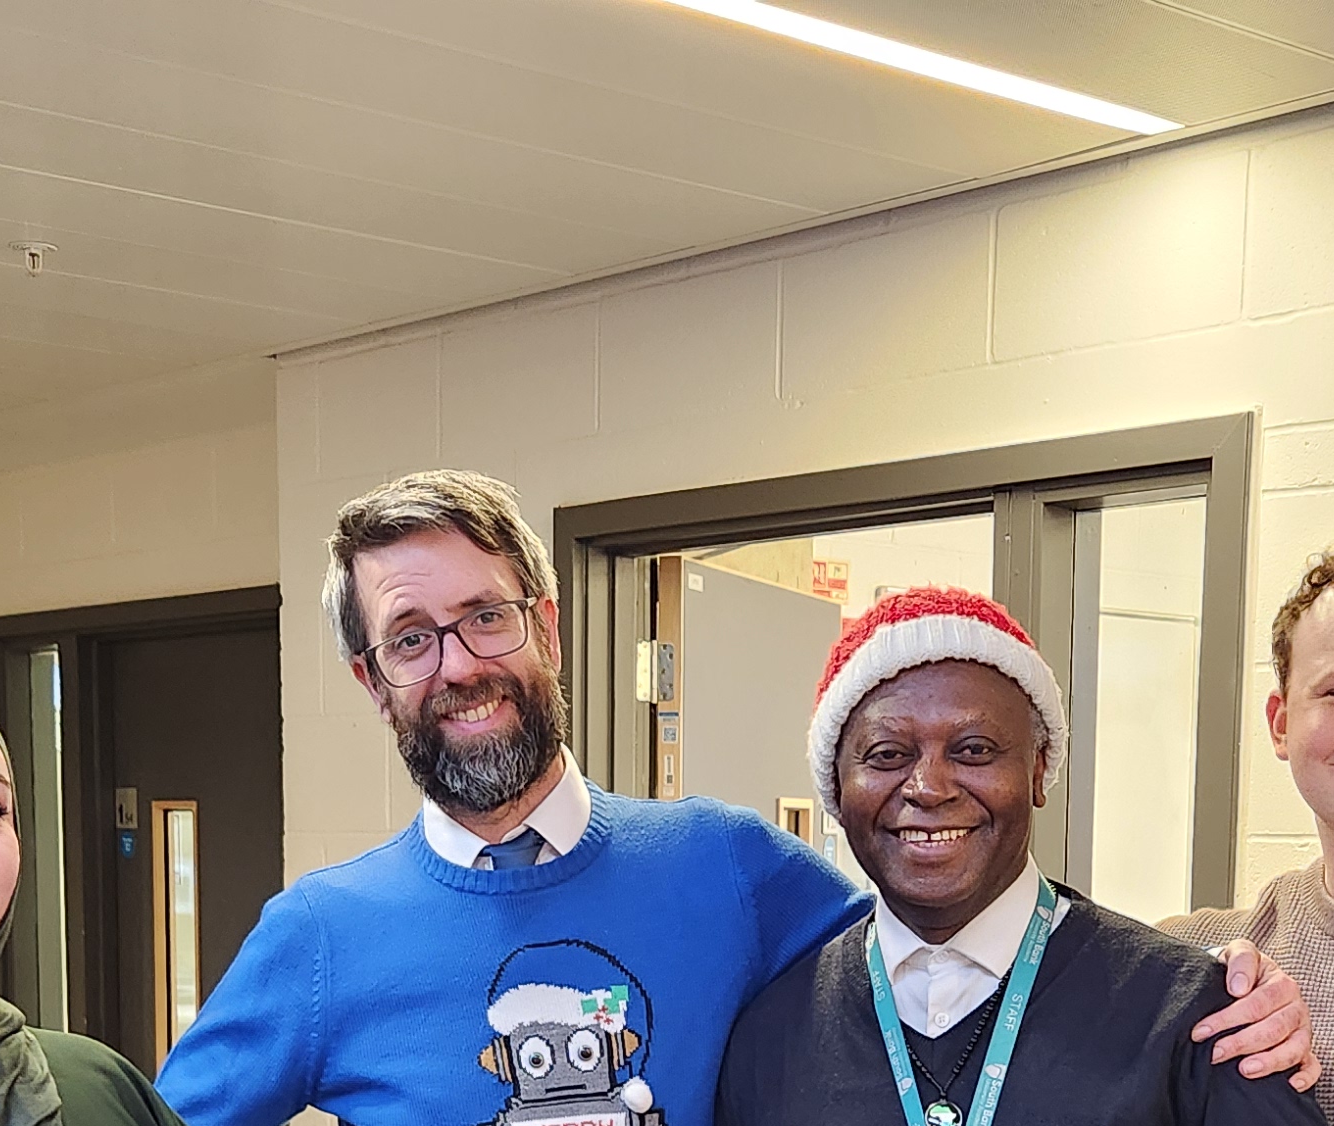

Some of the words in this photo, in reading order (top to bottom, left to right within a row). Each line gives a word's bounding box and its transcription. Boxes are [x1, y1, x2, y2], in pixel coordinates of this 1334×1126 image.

[872, 970, 886, 1001] STAFF
[1004, 993, 1023, 1032] STAFF
[984, 1080, 1001, 1108] South
